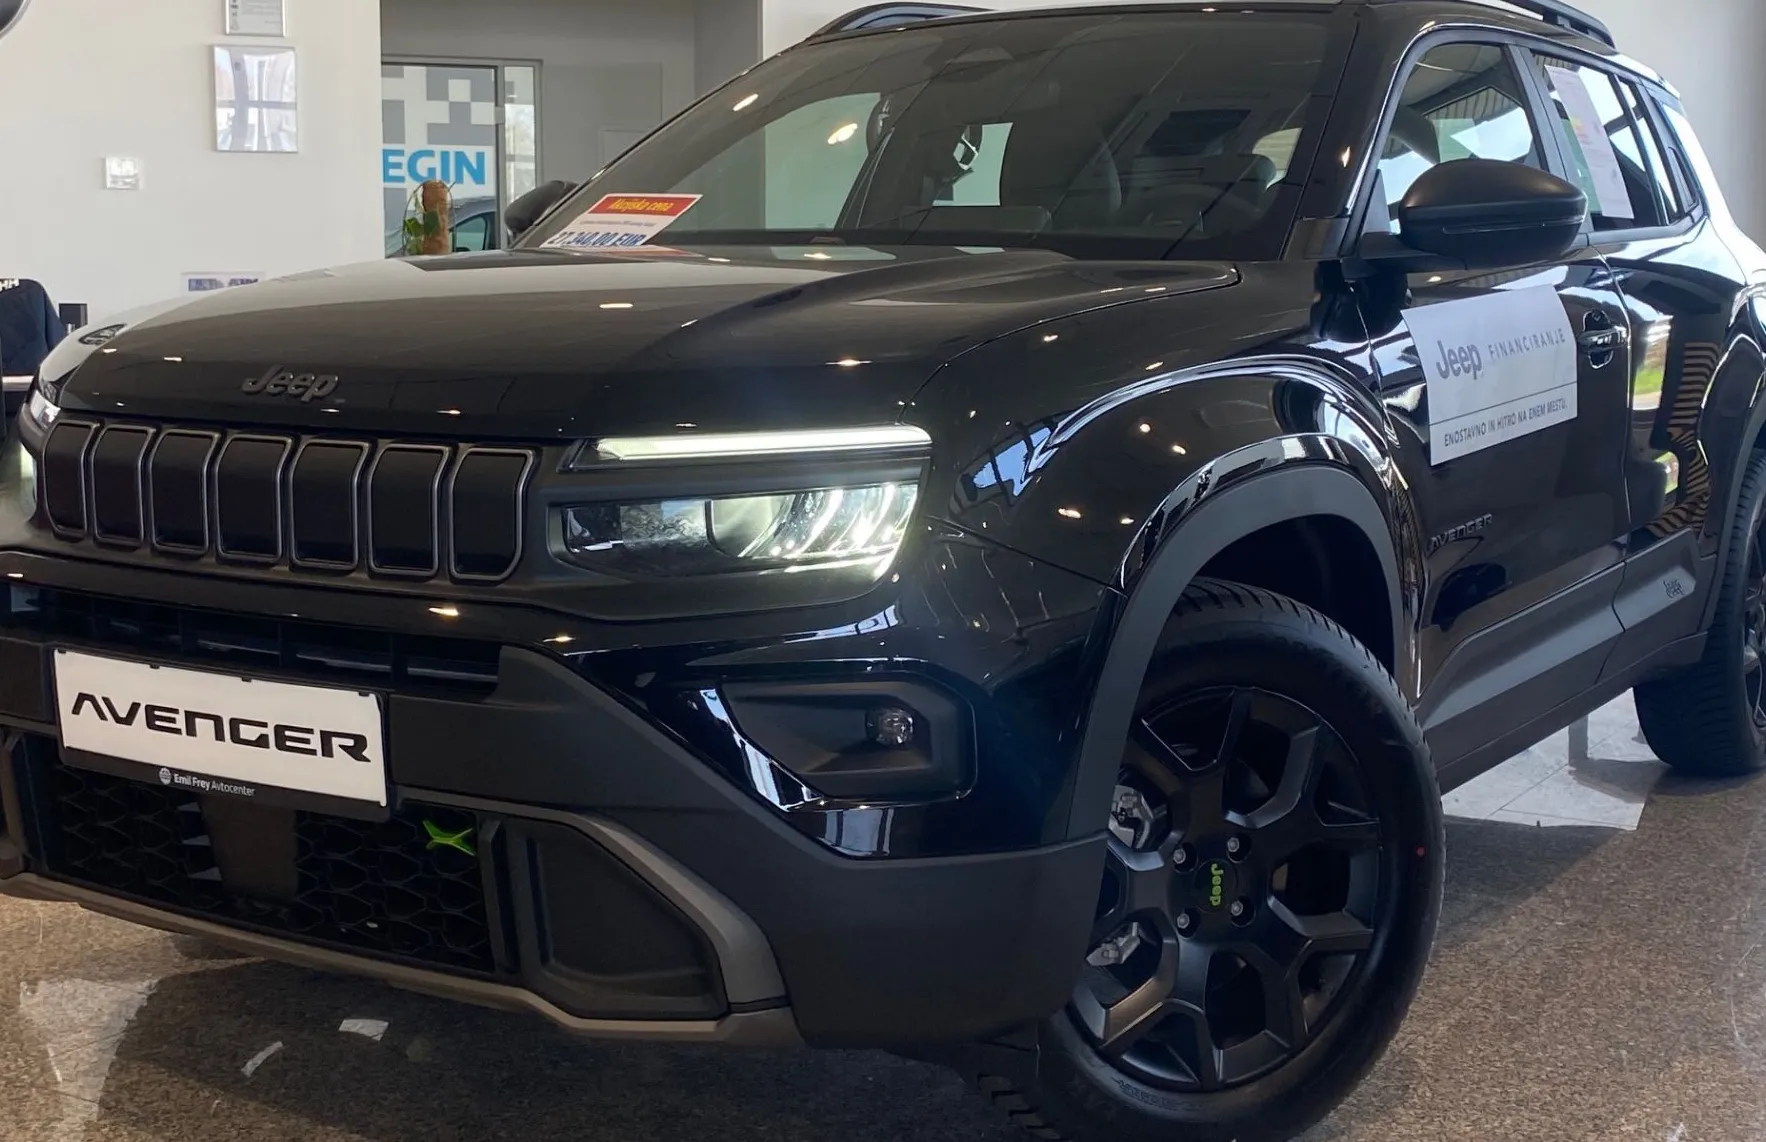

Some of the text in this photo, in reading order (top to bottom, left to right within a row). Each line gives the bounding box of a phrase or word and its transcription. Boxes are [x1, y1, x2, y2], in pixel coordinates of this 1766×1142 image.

[613, 232, 647, 247] EUR
[1436, 328, 1566, 380] Jeep FINANCIRANJE
[242, 364, 339, 404] Jeep
[1444, 422, 1486, 447] ENOSTAVNO
[1488, 418, 1496, 432] IN
[1497, 414, 1516, 430] HITRO
[1518, 410, 1527, 423] NA
[1528, 403, 1546, 419] ENEM
[1429, 513, 1493, 550] AVENGER
[71, 691, 371, 763] AVENGER
[174, 773, 255, 796] Emil Frey Avtocenter
[1209, 863, 1224, 906] Jeep
